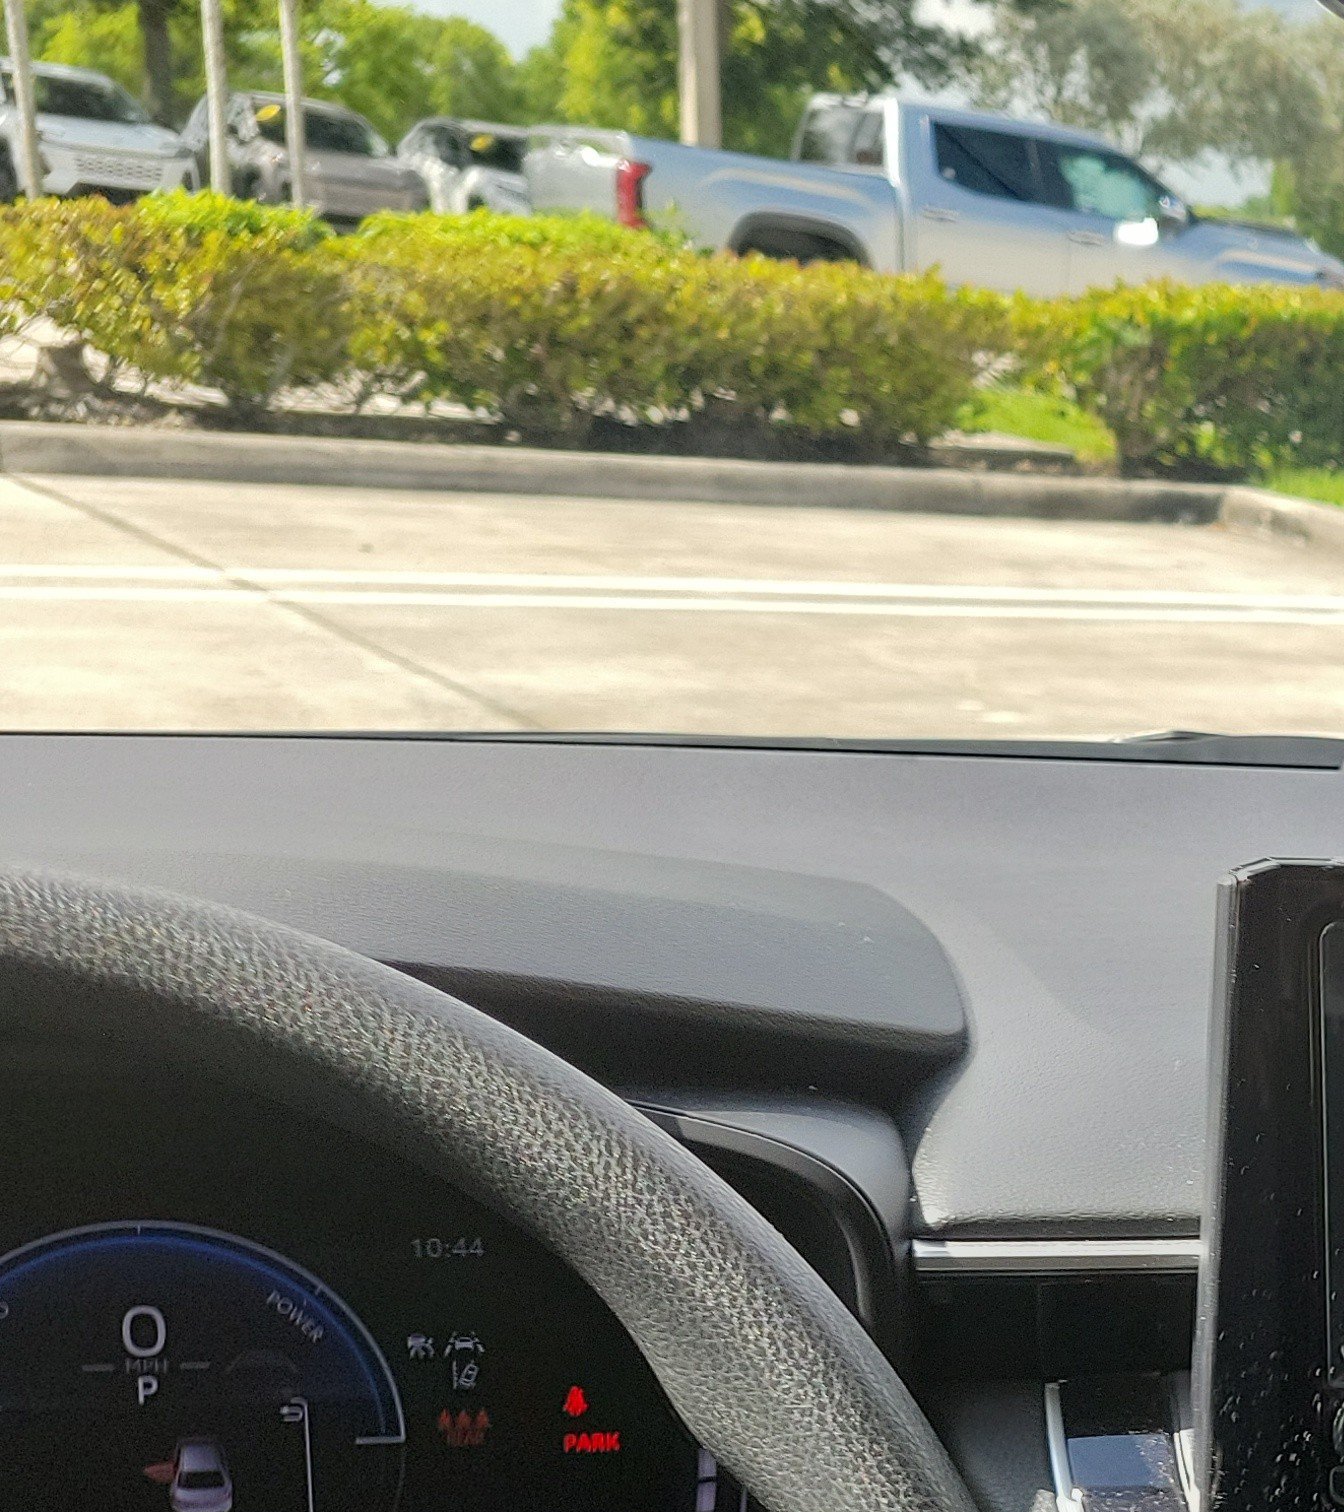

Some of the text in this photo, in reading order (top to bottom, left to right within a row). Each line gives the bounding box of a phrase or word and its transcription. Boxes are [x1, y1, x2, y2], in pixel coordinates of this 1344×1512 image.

[411, 1238, 485, 1258] 10:44
[266, 1289, 324, 1344] POWER
[125, 1358, 168, 1374] MPH
[138, 1375, 159, 1405] P
[563, 1431, 622, 1453] PARK
